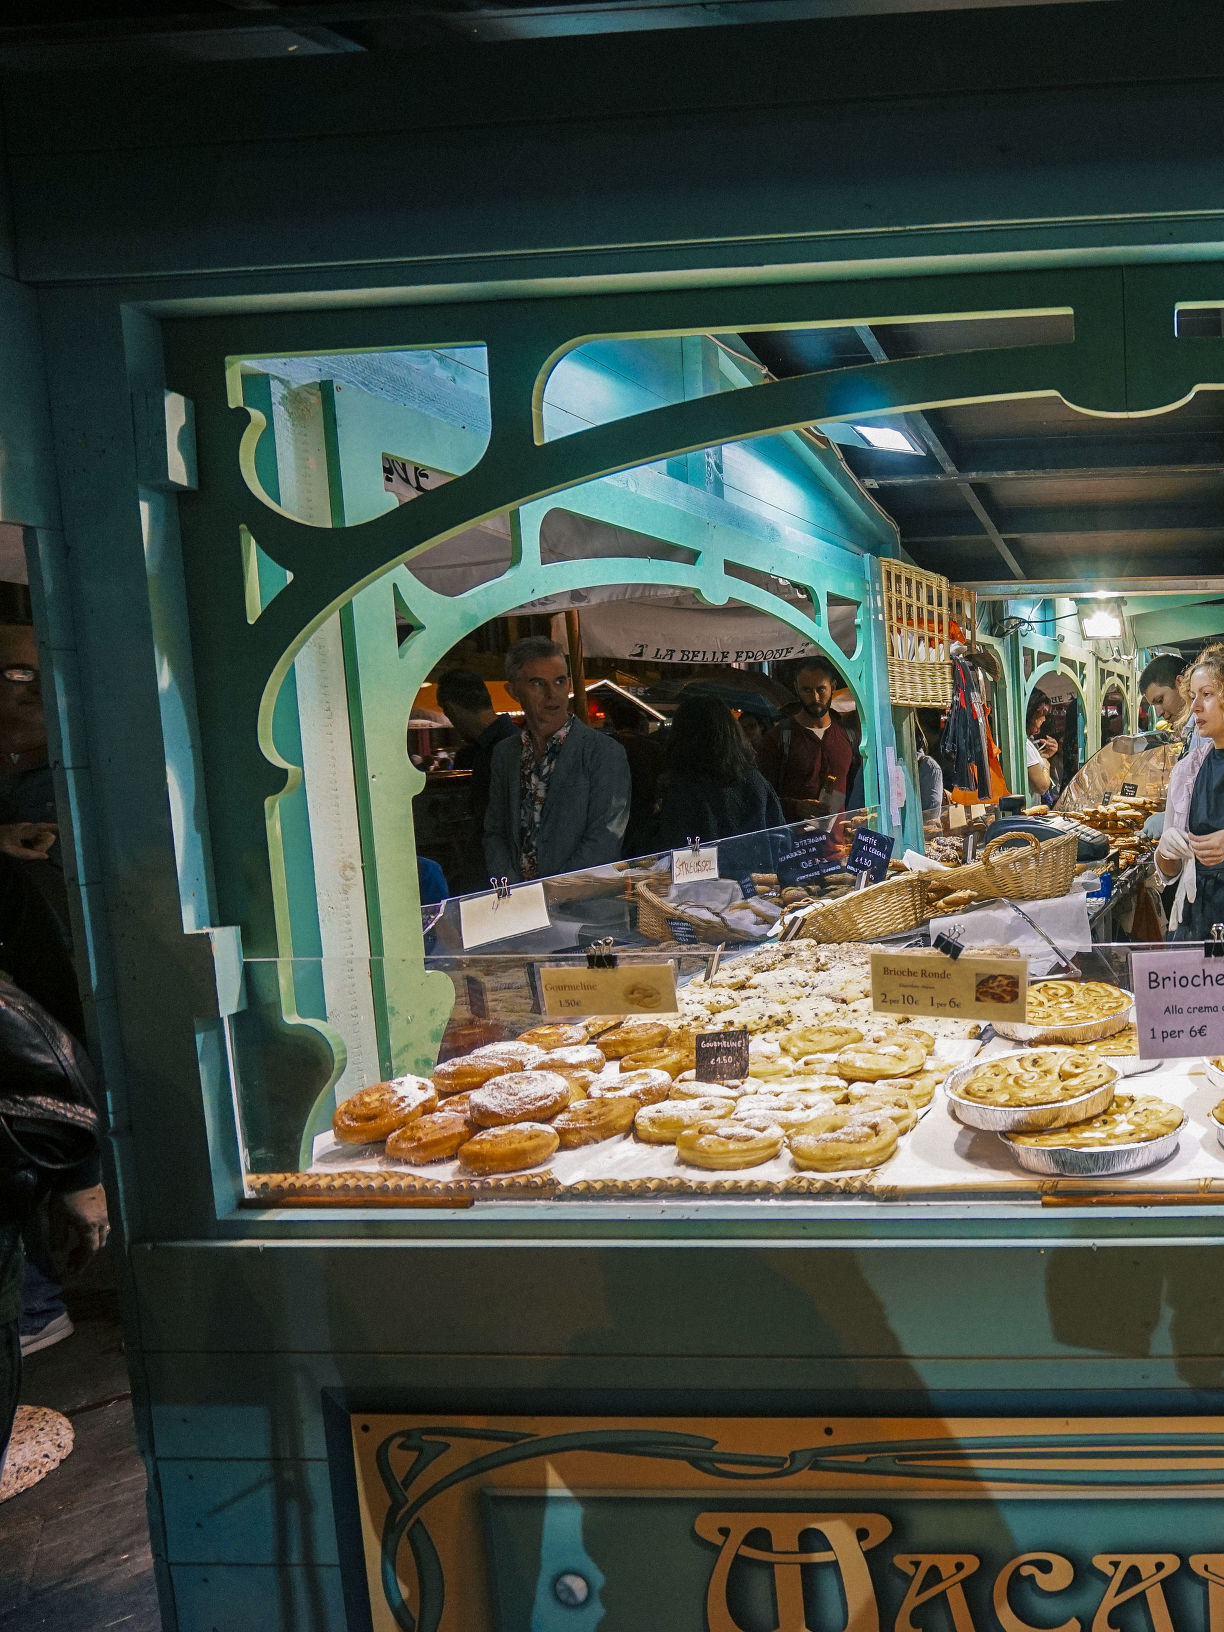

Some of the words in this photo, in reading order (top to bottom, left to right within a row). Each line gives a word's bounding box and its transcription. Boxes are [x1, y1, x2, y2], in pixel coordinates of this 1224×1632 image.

[651, 648, 675, 660] LA
[679, 650, 729, 662] BELLE
[883, 966, 919, 978] Brioche
[920, 968, 952, 980] Ronde
[544, 981, 599, 992] Gourmeline
[880, 992, 888, 1003] 2
[930, 996, 935, 1007] 1
[1163, 1004, 1184, 1015] Alla
[1186, 1004, 1219, 1014] crema
[1150, 1028, 1156, 1040] 1
[1161, 1028, 1185, 1042] per
[1189, 1025, 1208, 1038] 6€
